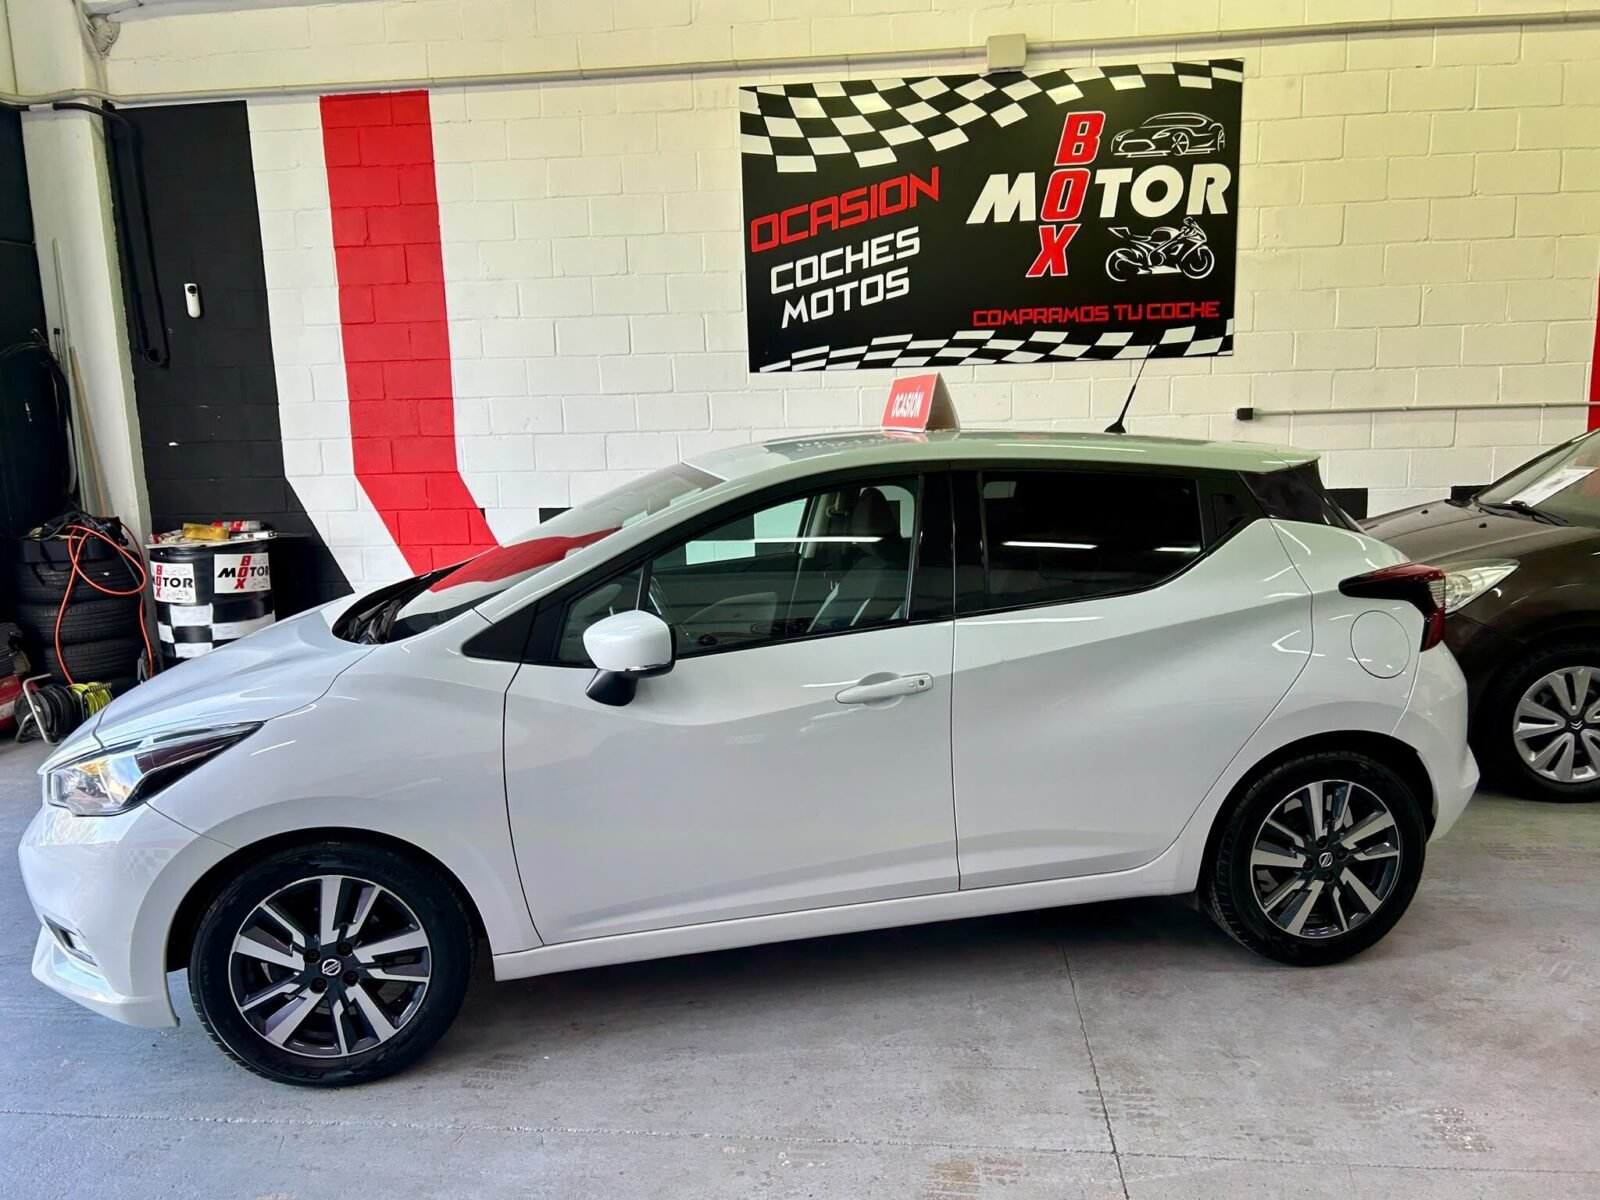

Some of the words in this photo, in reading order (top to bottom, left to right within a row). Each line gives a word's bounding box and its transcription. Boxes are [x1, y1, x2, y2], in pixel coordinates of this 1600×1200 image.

[750, 165, 940, 253] OCASION
[966, 163, 1232, 225] MOTOR
[1026, 111, 1106, 278] BOX
[770, 226, 920, 294] COCHES
[781, 266, 909, 329] MOTOS
[973, 305, 1109, 327] COMPRAMOS
[1113, 303, 1143, 321] TU
[1146, 301, 1221, 320] COCHE
[891, 385, 924, 418] OCASIÓN
